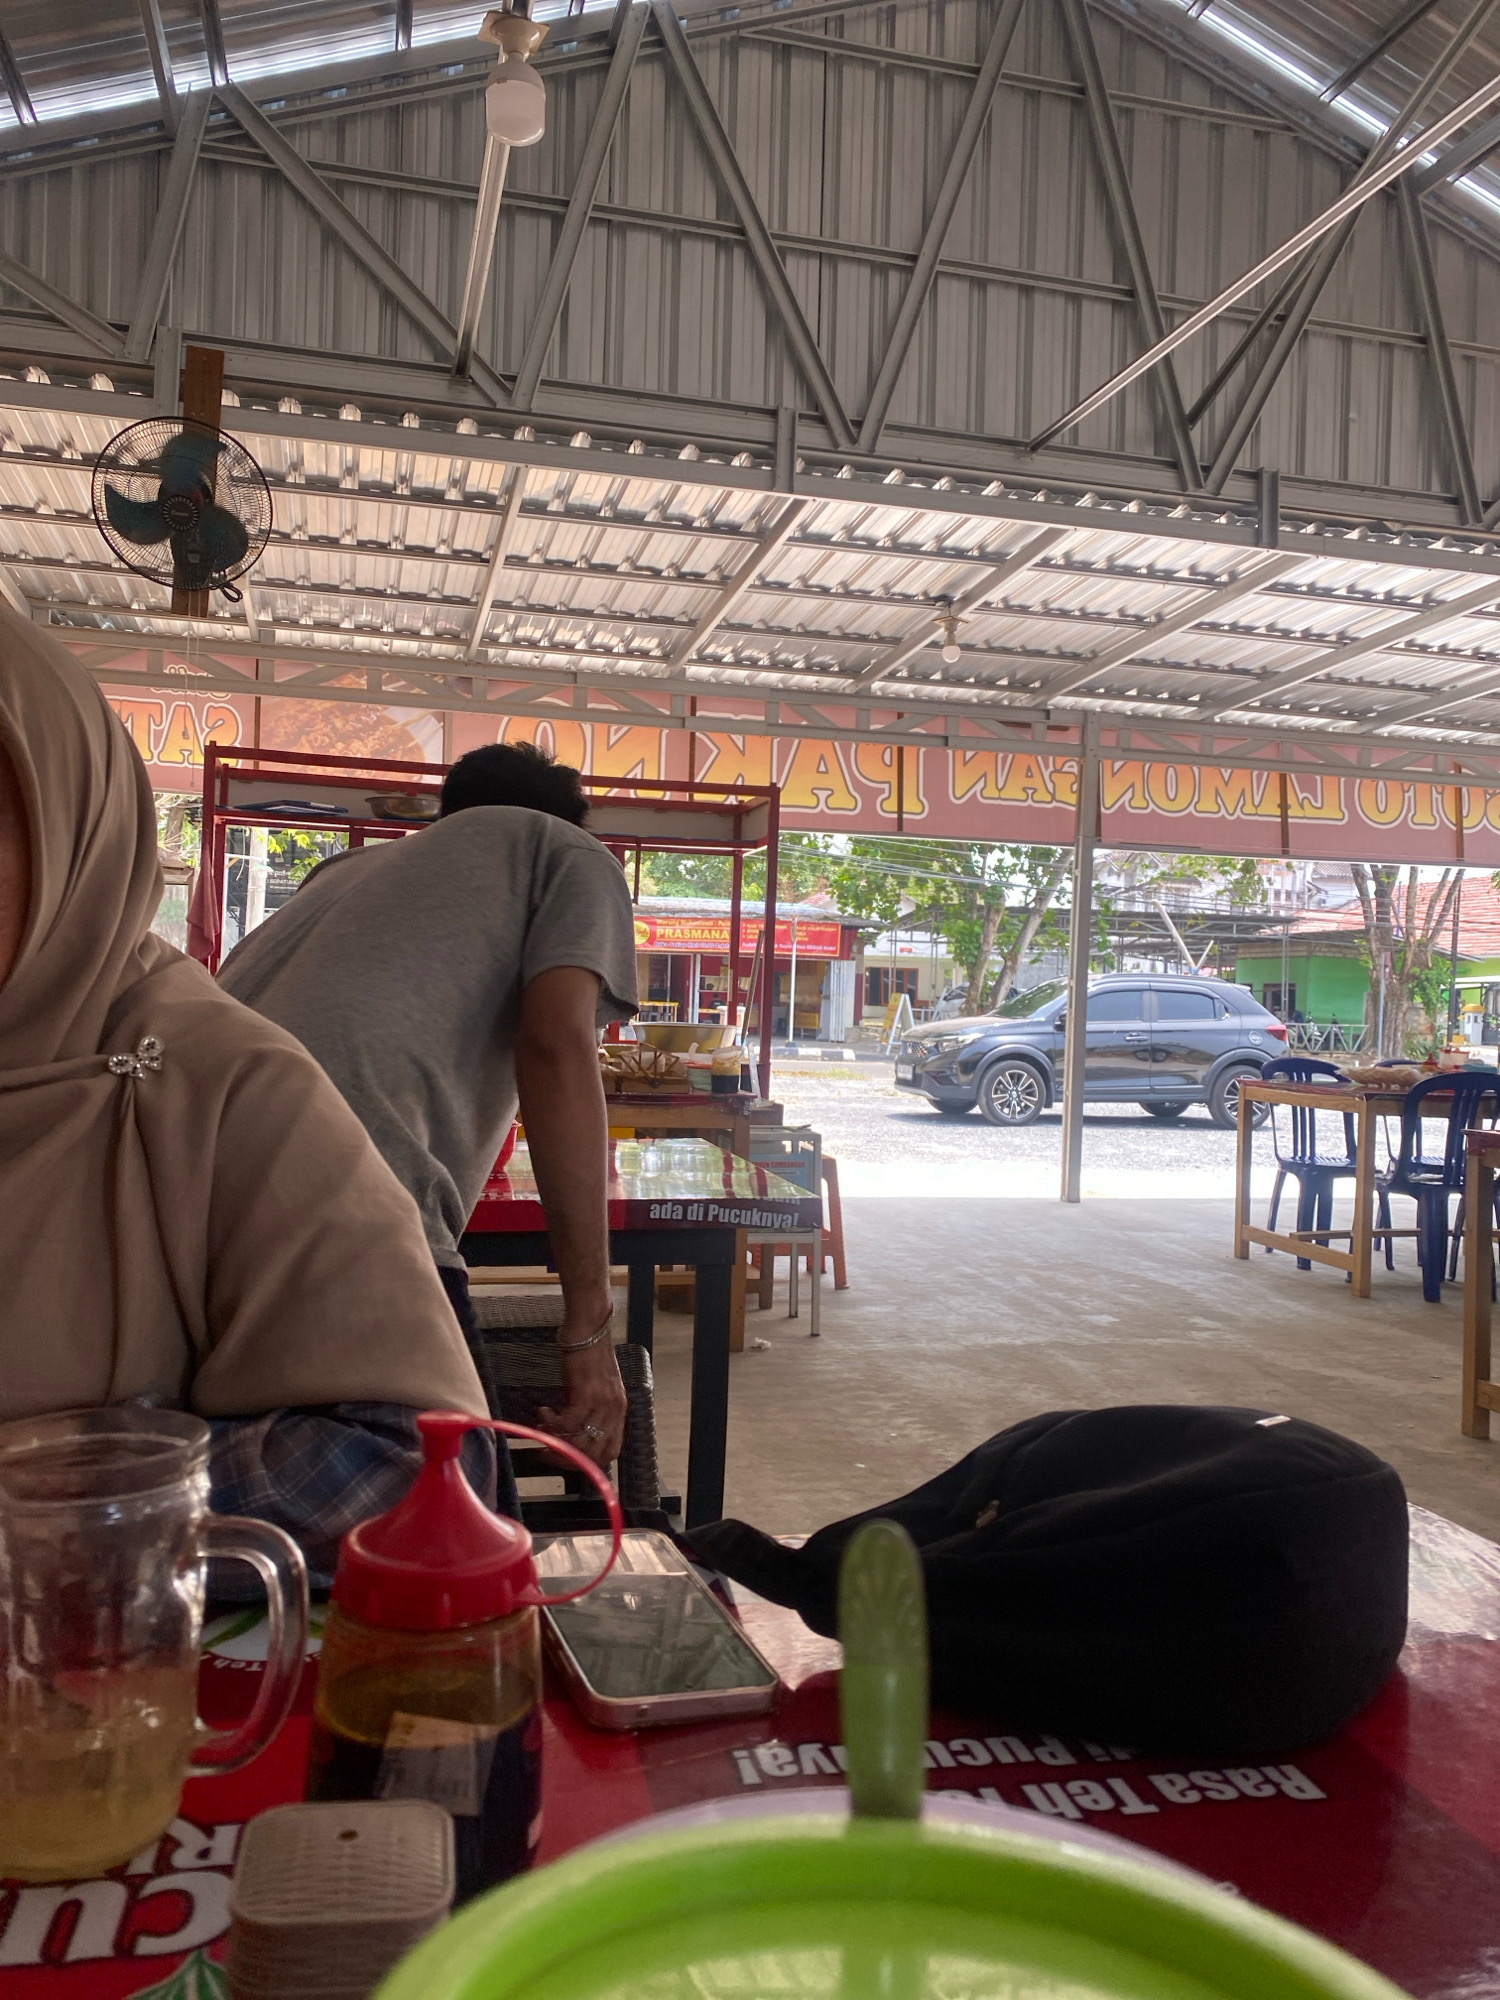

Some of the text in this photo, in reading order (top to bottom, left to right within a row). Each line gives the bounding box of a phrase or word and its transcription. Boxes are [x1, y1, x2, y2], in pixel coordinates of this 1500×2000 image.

[656, 928, 730, 940] PRASMANA
[650, 1202, 800, 1229] ada di Pucuknya!
[733, 1735, 1078, 1785] Pucuya!
[1021, 1777, 1160, 1820] Teh
[1147, 1763, 1327, 1804] Rasa
